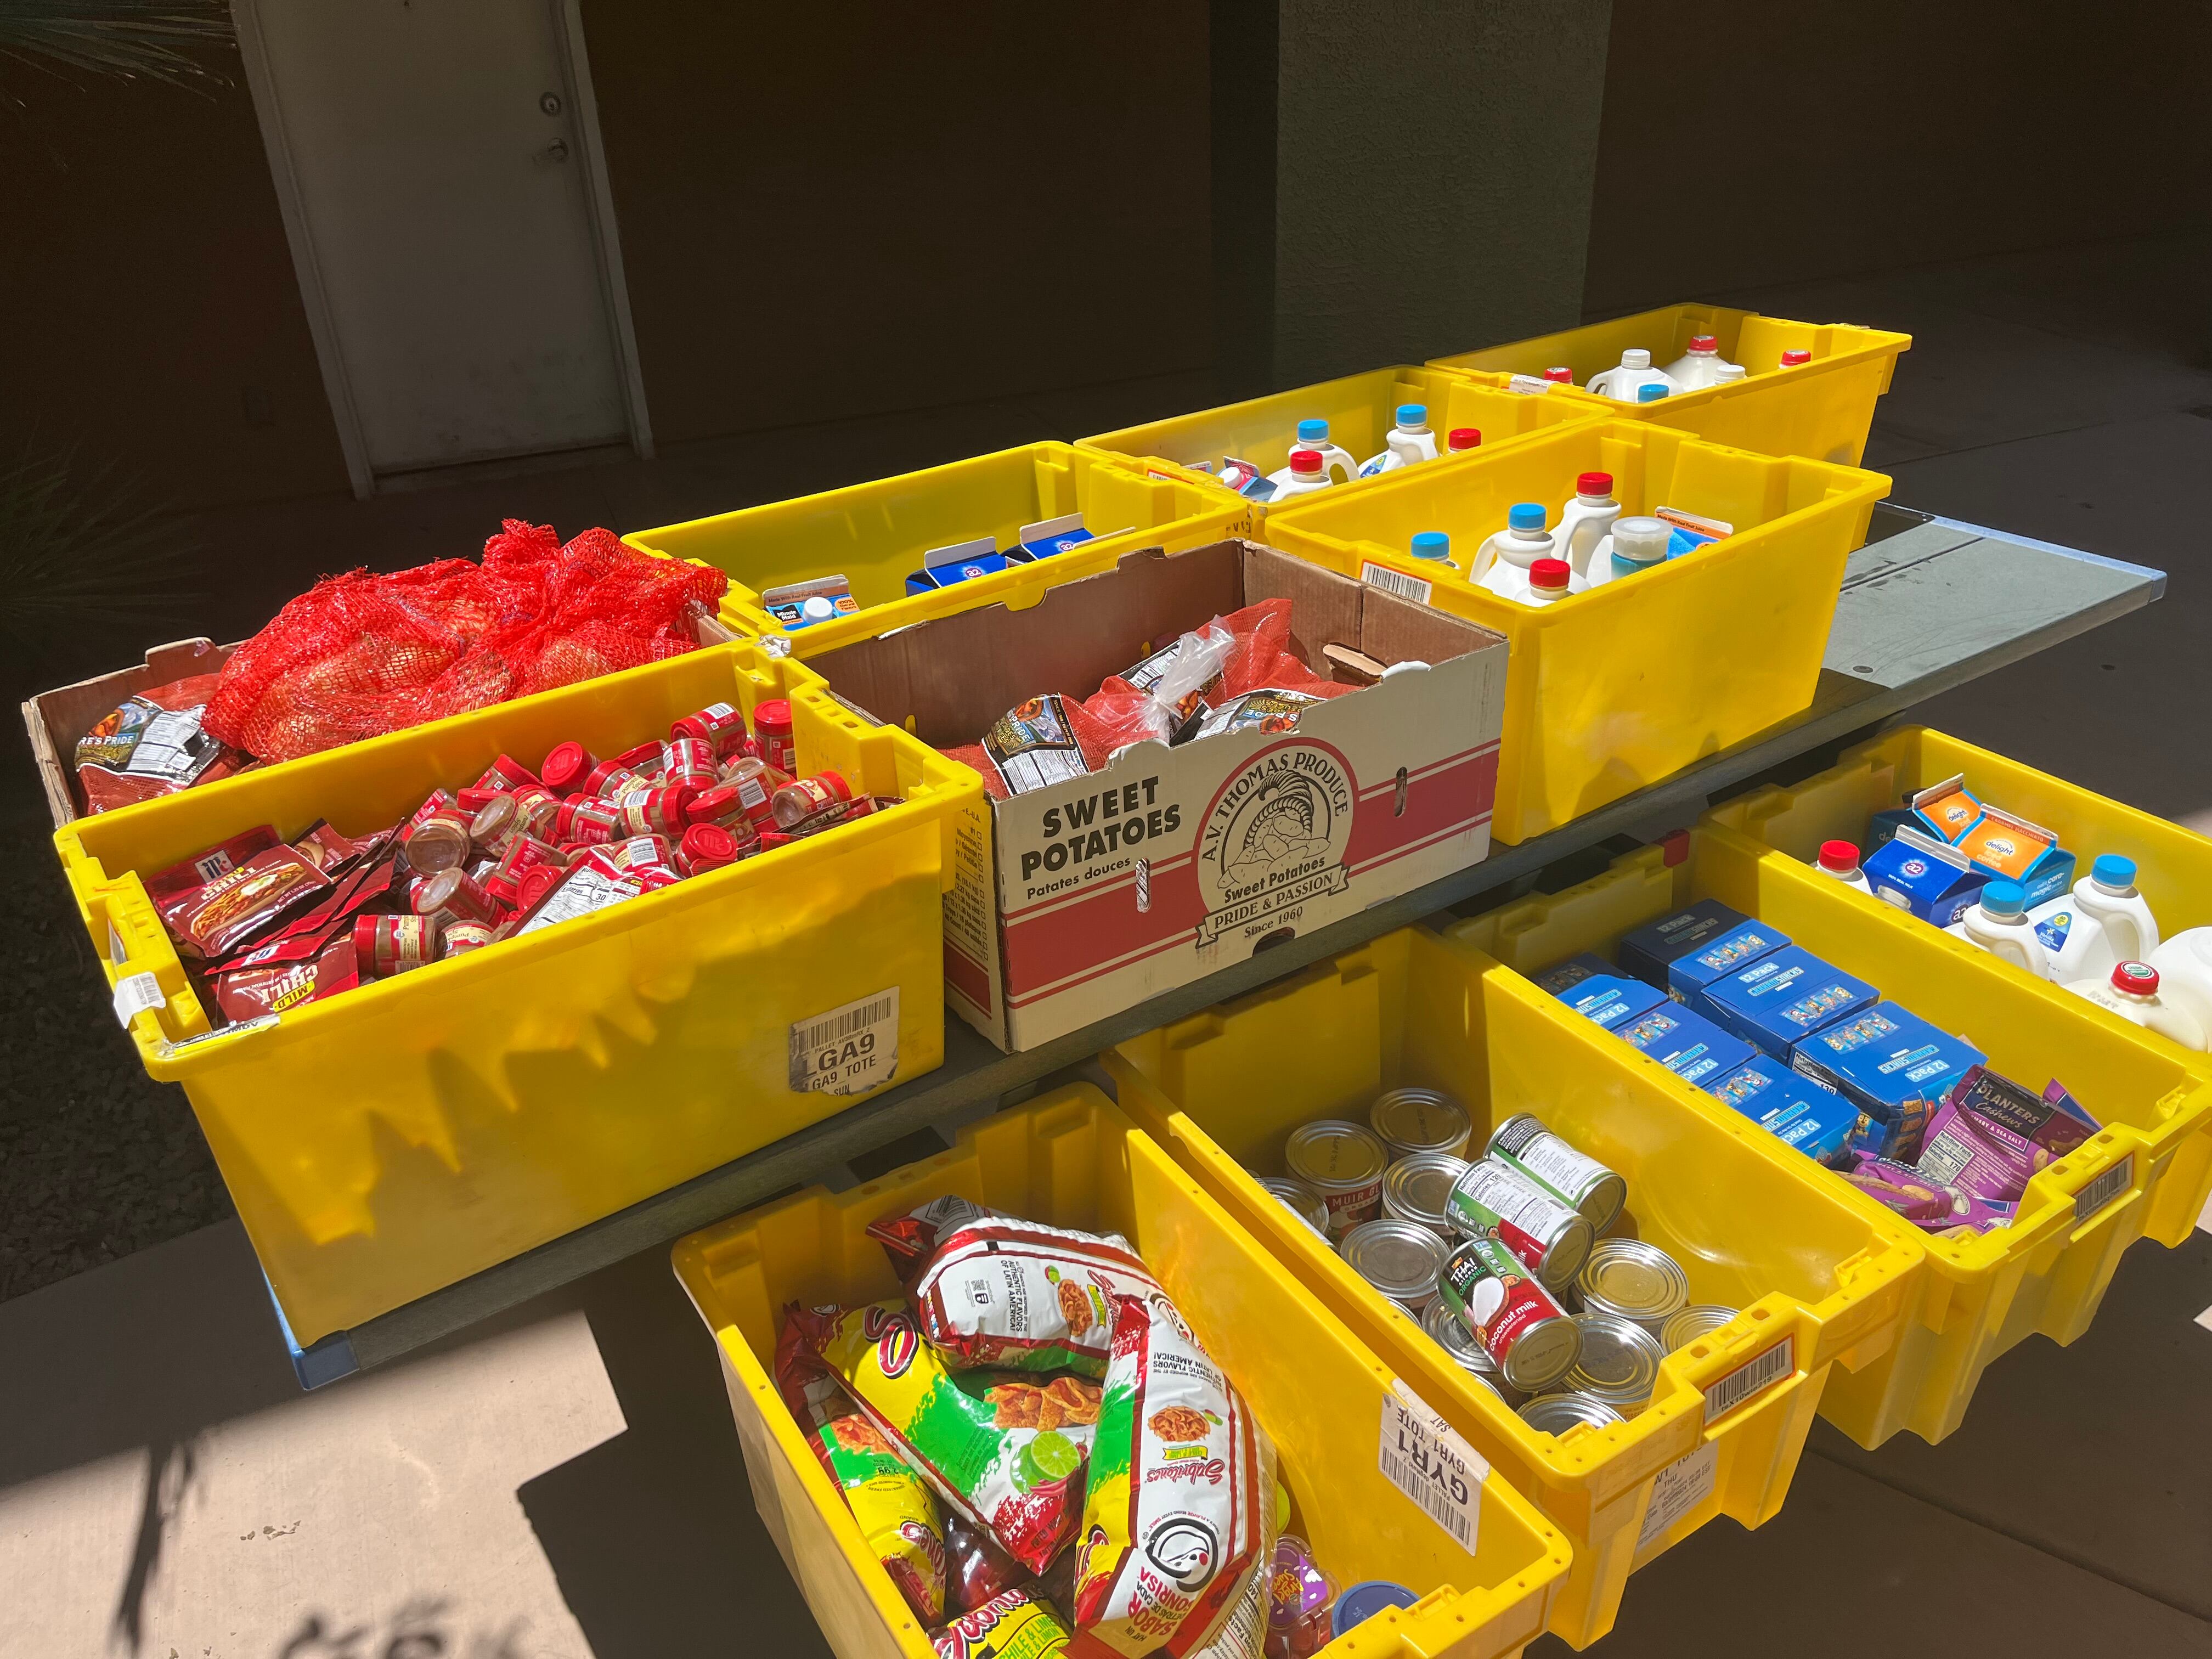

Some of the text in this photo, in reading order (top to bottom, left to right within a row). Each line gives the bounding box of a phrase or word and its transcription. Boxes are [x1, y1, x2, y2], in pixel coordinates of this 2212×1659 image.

[777, 610, 797, 618] Minute
[1011, 714, 1031, 742] PRIDE
[104, 734, 134, 746] PRIDE
[1042, 775, 1159, 838] SWEET
[1201, 752, 1348, 862] A.V. THOMAS PRODUCE
[1948, 809, 1967, 822] delight
[1990, 816, 2044, 843] CARAMEL MACCHIATO
[1020, 804, 1181, 882] POTATOES
[1985, 840, 2014, 856] delight
[1906, 863, 1922, 874] a2
[1976, 854, 2002, 868] coffee
[201, 867, 257, 900] CHILI
[1026, 857, 1131, 900] Patates douces
[1224, 856, 1325, 904] Sweet Potatoes
[1214, 872, 1334, 929] PRIDE & PASSION
[1244, 906, 1303, 939] Since 1960
[1669, 914, 1693, 928] Pack
[261, 964, 319, 1004] CHILI
[1741, 963, 1777, 983] 12 Pack
[277, 986, 308, 1008] MILD
[1615, 1003, 1628, 1012] 12
[815, 1042, 836, 1054] PALLET
[819, 1033, 875, 1071] GA9
[812, 1054, 876, 1090] GA9 TOTE
[1701, 1059, 1717, 1069] 12
[1908, 1061, 1948, 1080] 12 Pack
[834, 1084, 850, 1096] SUN
[1975, 1102, 2023, 1128] Cashews
[1976, 1085, 2041, 1125] PLANTERS
[1803, 1121, 1819, 1131] 12
[1996, 1128, 2007, 1137] SEA
[2007, 1135, 2023, 1145] SALT
[1928, 1146, 1944, 1160] Calories
[1940, 1132, 1972, 1158] Nutrition Facts
[1949, 1161, 1961, 1172] 170
[1459, 1171, 1475, 1191] Nutrition
[1475, 1183, 1491, 1200] Calories
[1489, 1173, 1502, 1182] 120
[1332, 1192, 1364, 1207] MUIR
[1001, 1260, 1009, 1268] OF
[1450, 1257, 1476, 1283] THAI
[1003, 1270, 1014, 1288] LATIN
[1008, 1260, 1022, 1296] AUTHENTIC
[1458, 1266, 1487, 1296] ORGANIC
[1489, 1300, 1539, 1352] coconut milk
[1499, 1313, 1527, 1345] unsweetened
[1153, 1360, 1186, 1372] FLAVORS
[1154, 1352, 1193, 1366] AMERICA!
[1195, 1361, 1212, 1375] LATIN
[1430, 1417, 1452, 1432] SAT
[1397, 1408, 1465, 1476] GYR1 TOTE
[1146, 1458, 1226, 1486] Sabritones
[1398, 1429, 1469, 1505] GYR1
[1431, 1482, 1451, 1502] PALLET
[1663, 1474, 1677, 1488] THU
[1149, 1517, 1162, 1528] SMILE
[1187, 1511, 1206, 1521] FLAVOR
[1139, 1565, 1194, 1611] SONRISA
[1273, 1568, 1295, 1590] Swee
[1136, 1580, 1162, 1613] DE CADA
[1248, 1584, 1259, 1600] 140
[1272, 1577, 1304, 1605] Angel
[1127, 1590, 1177, 1636] SABOR
[1025, 1614, 1058, 1641] & LIME
[1125, 1626, 1147, 1642] HAY UN
[1228, 1615, 1246, 1639] Facts
